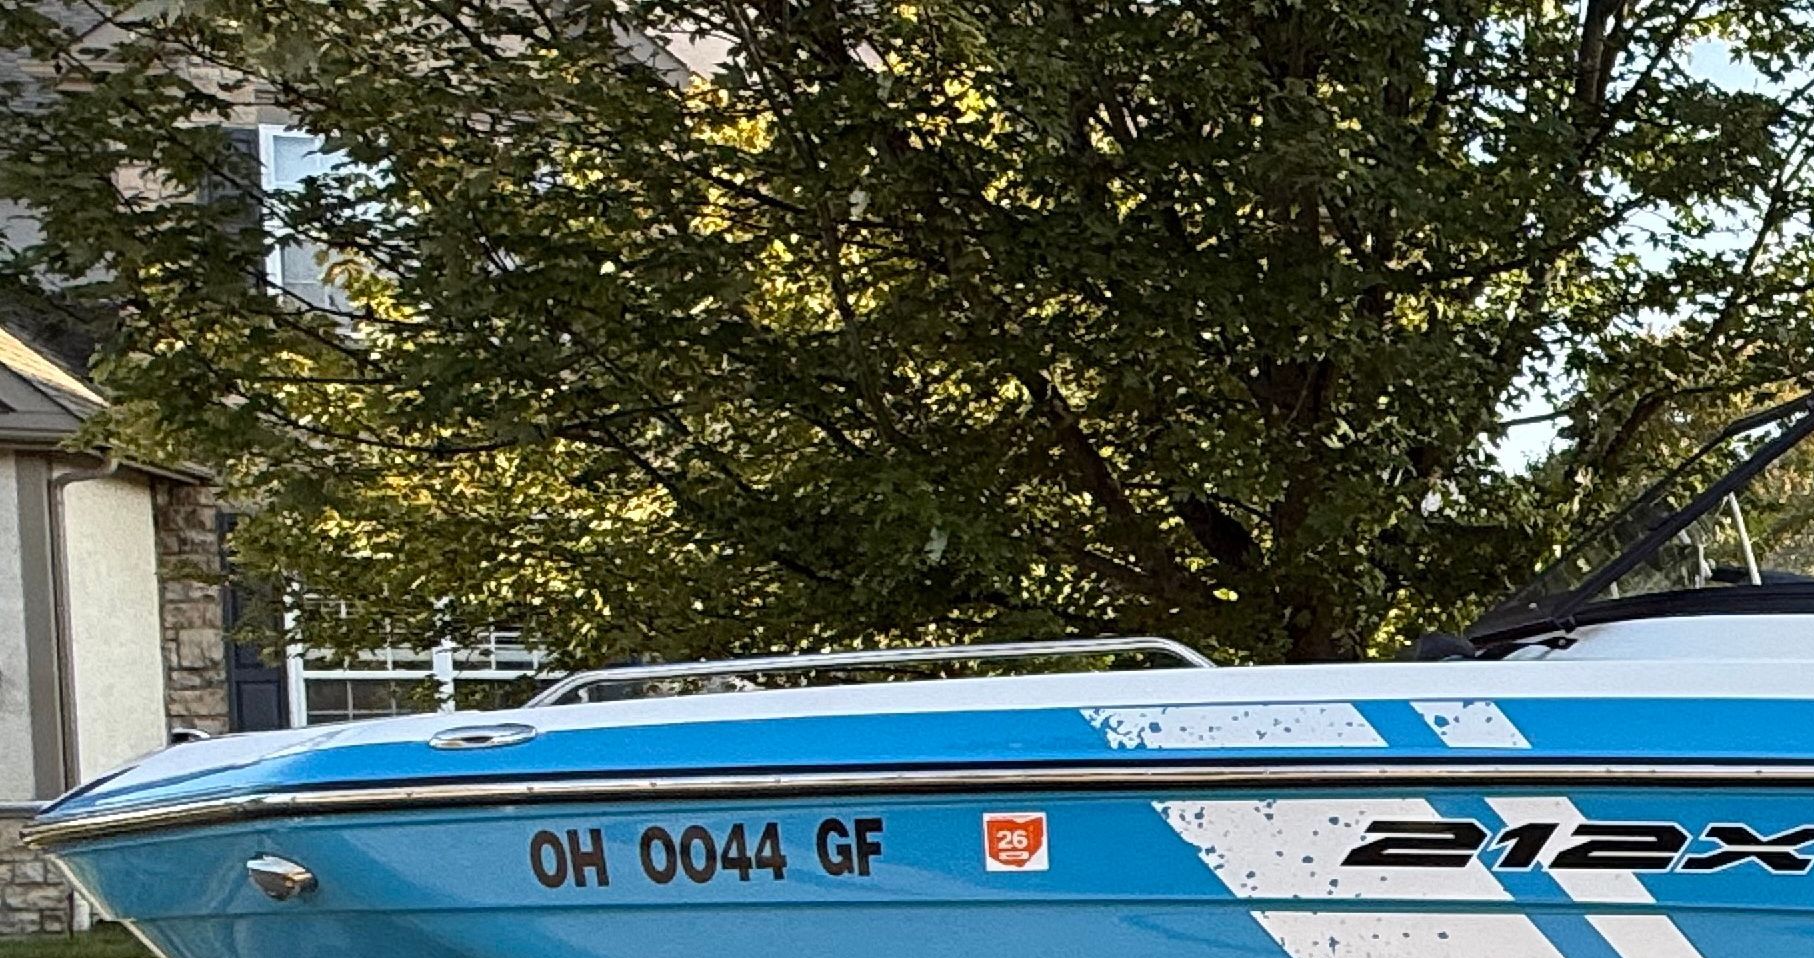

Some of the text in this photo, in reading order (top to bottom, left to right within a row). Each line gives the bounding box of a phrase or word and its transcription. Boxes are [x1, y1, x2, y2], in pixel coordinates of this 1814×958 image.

[530, 817, 884, 888] OH 0044 GF
[996, 829, 1029, 850] 26
